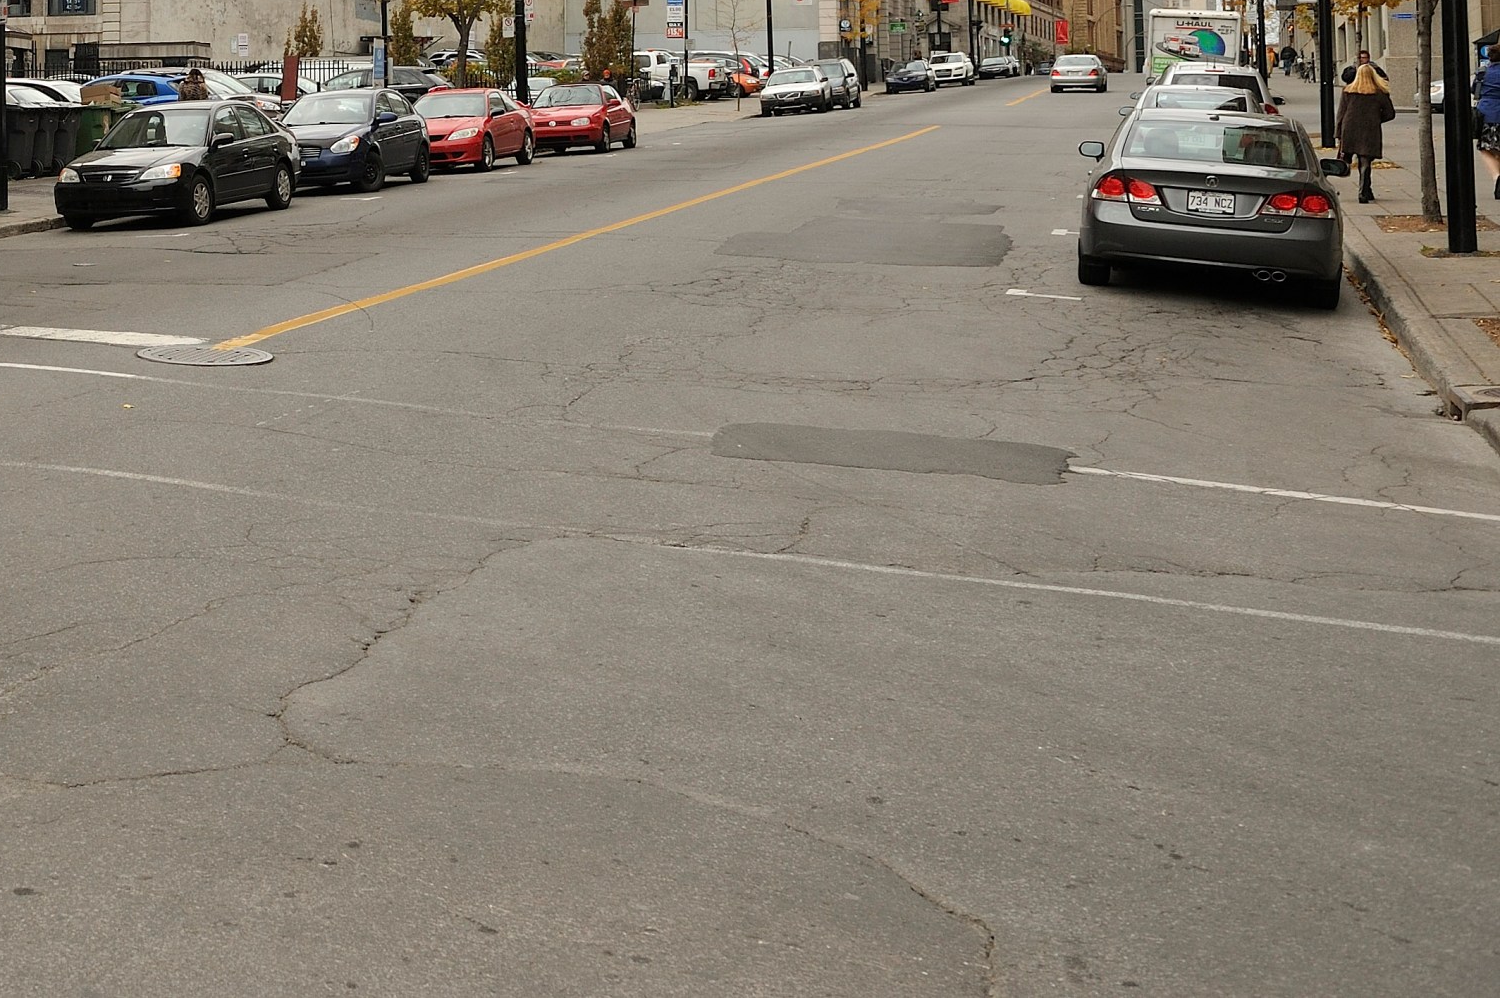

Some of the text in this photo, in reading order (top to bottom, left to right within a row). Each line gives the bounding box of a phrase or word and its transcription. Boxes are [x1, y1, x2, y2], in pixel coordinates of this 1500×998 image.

[1176, 20, 1213, 28] U-HAUL
[1190, 195, 1233, 209] 734 NCZ
